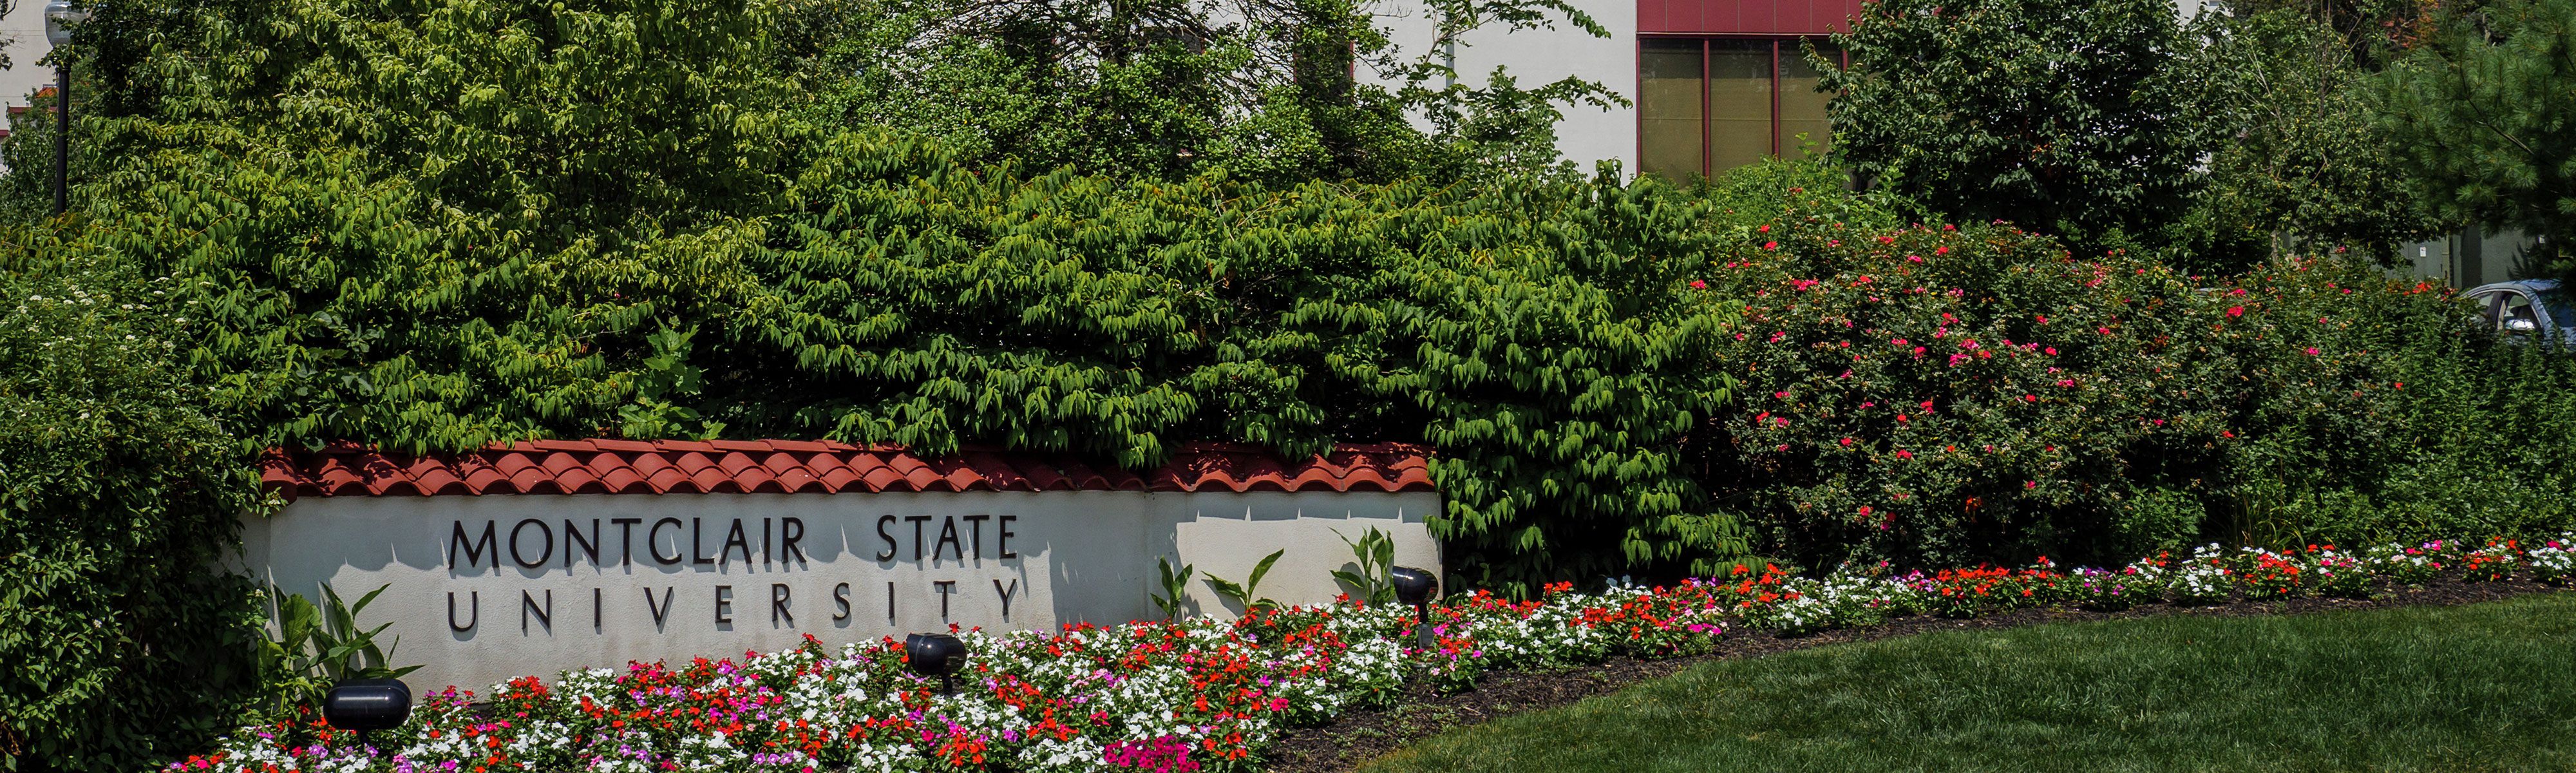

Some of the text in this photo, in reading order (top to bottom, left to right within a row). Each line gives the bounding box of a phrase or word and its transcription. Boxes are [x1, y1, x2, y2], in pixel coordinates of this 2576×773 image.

[449, 515, 1018, 569] MONTCLAIR STATE
[448, 578, 1017, 632] UNIVERSITY
